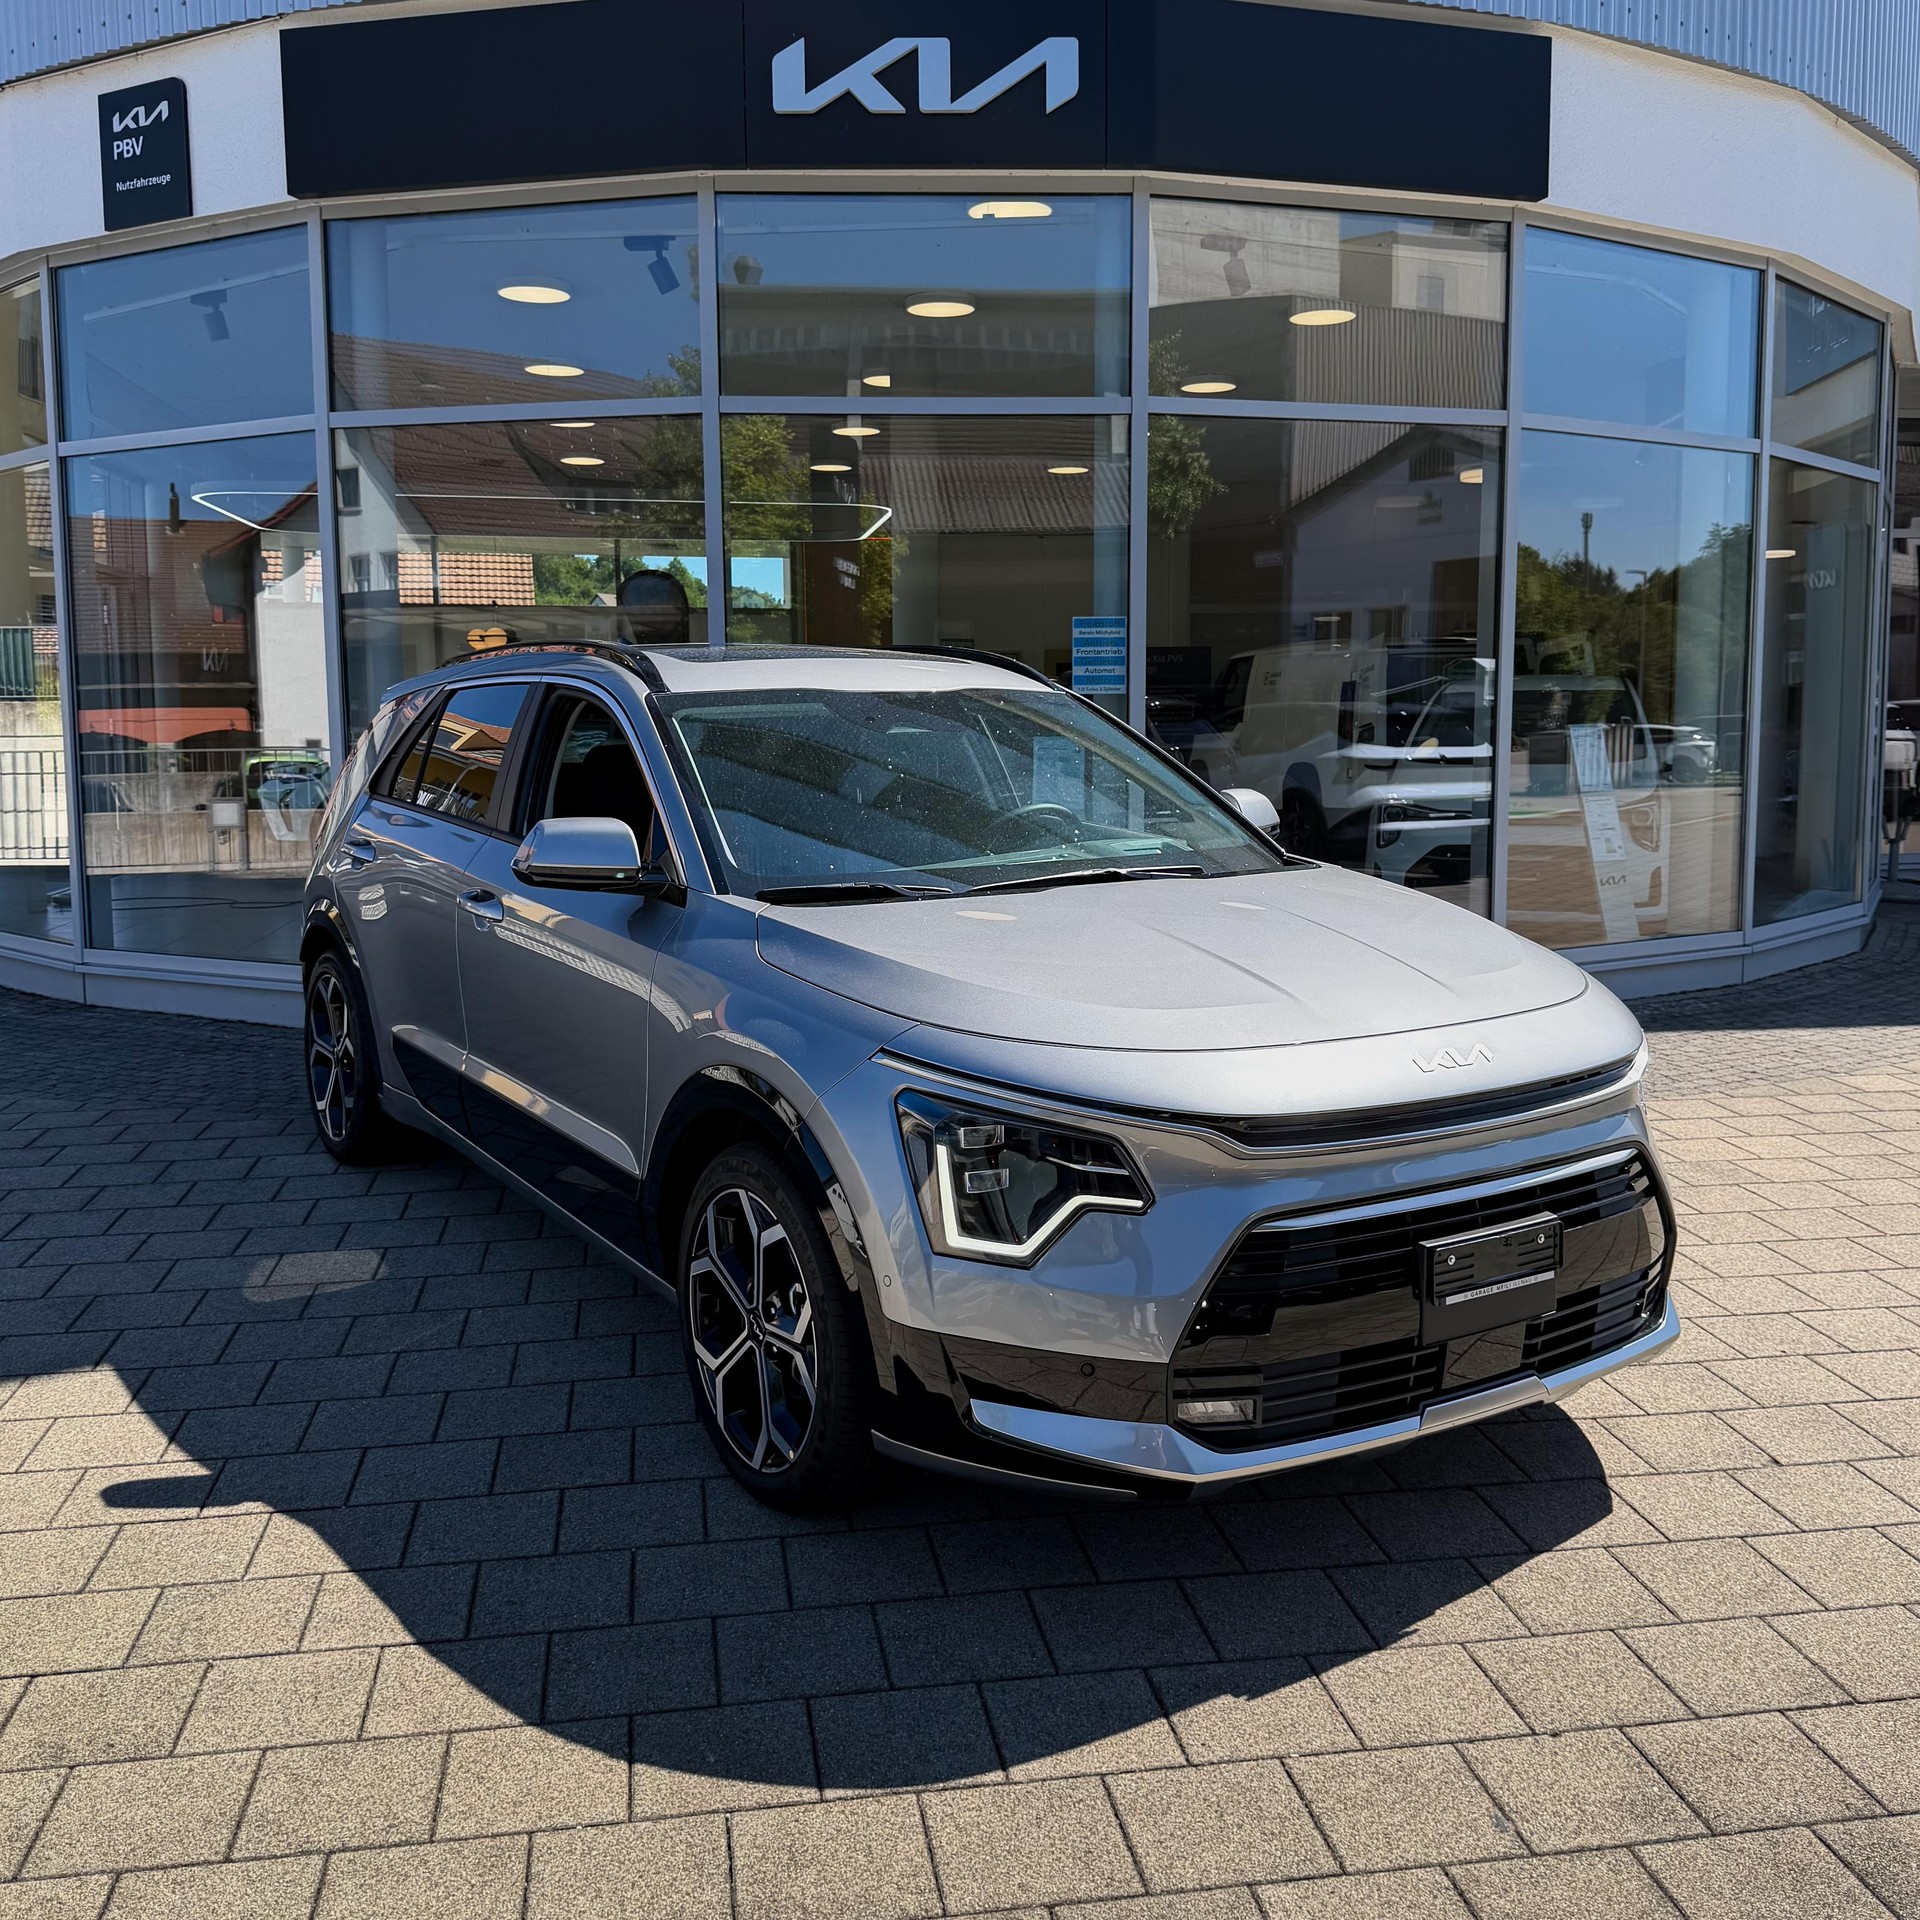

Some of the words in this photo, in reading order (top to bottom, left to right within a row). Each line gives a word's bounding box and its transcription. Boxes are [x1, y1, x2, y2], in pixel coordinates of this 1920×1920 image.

[772, 37, 1079, 115] KIA
[112, 100, 169, 133] KIA
[113, 135, 144, 161] PBV
[116, 173, 171, 192] Nutzfahrzeuge
[1076, 648, 1123, 656] Frontantrieb
[1083, 639, 1117, 647] Antrieb
[1599, 874, 1627, 887] KIA
[1412, 1042, 1495, 1073] KIA
[1470, 1287, 1494, 1298] GARAGE
